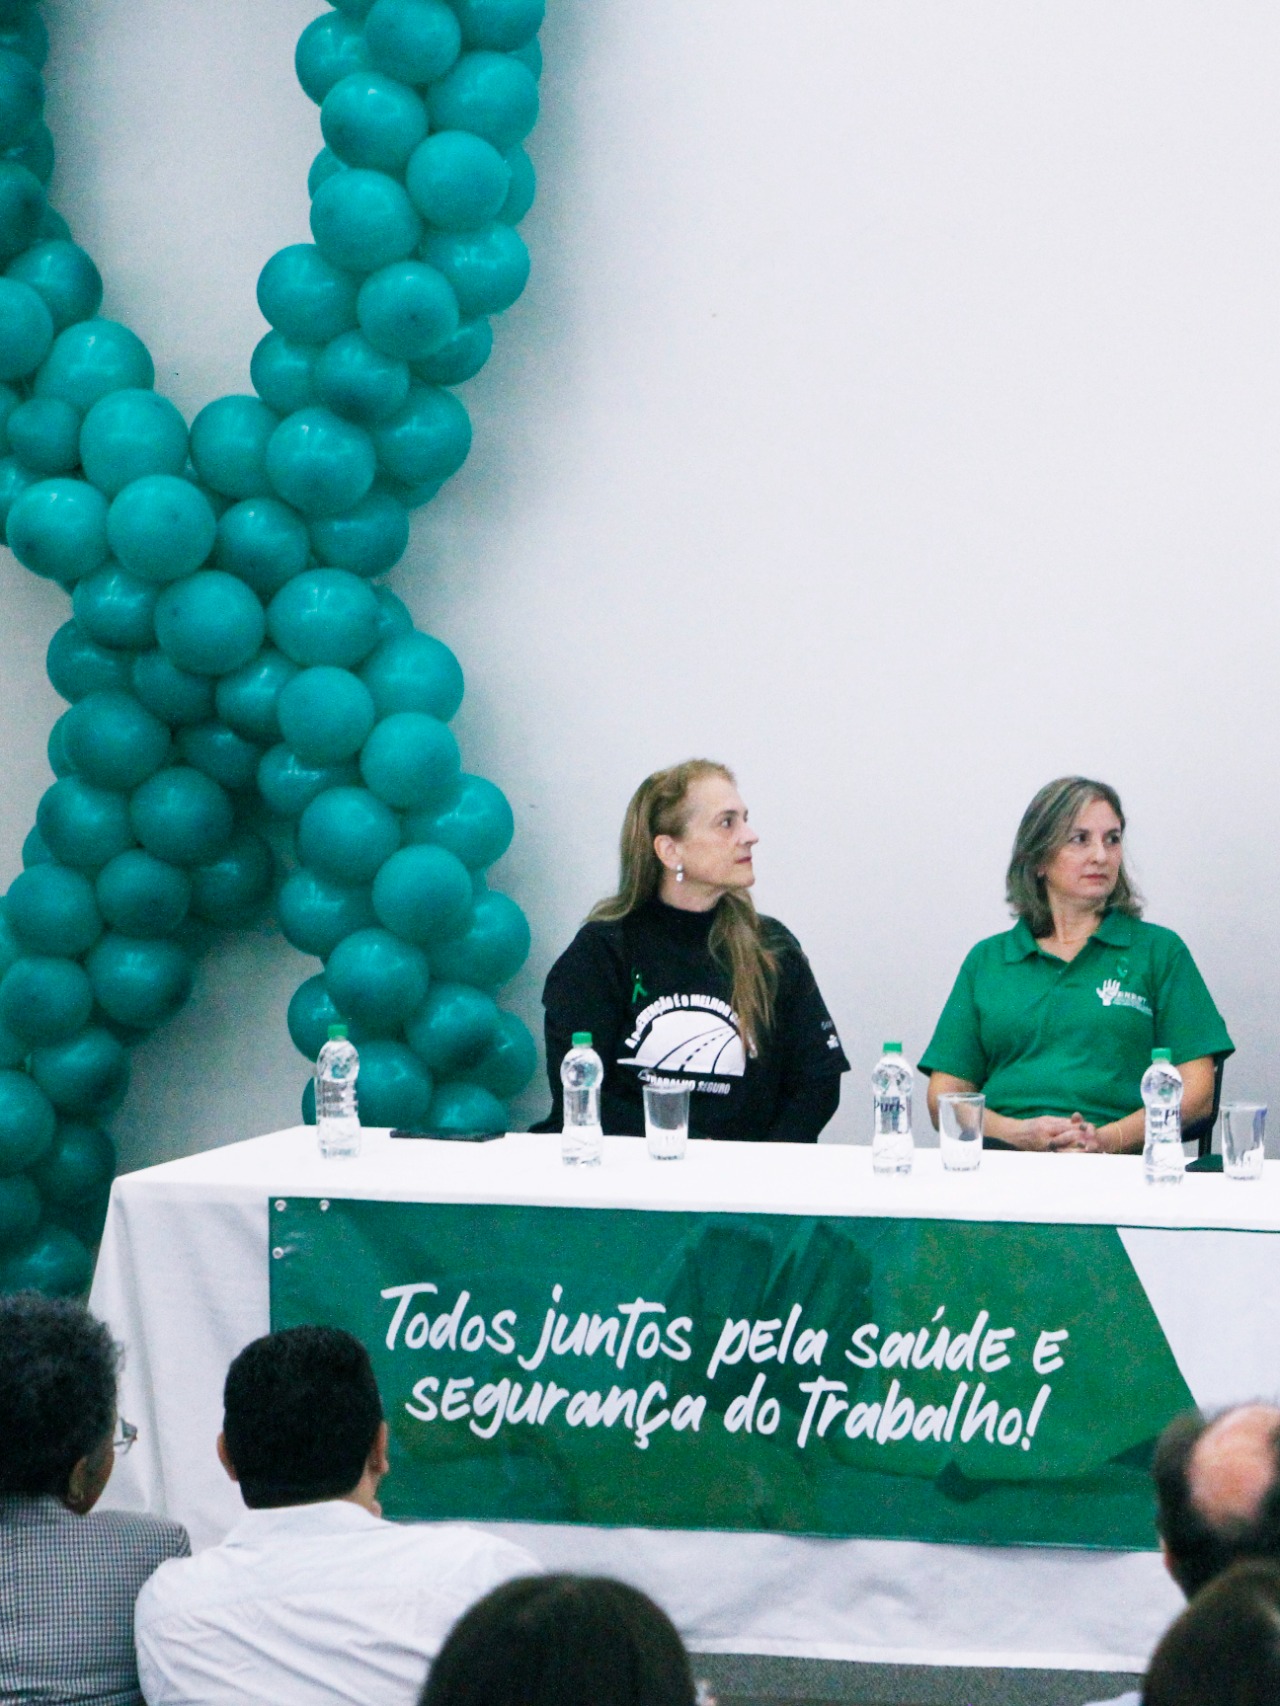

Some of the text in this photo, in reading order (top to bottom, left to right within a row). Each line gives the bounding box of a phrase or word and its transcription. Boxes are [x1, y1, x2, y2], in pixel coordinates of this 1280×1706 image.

[380, 1282, 517, 1355] Todos
[517, 1283, 693, 1371] juntos
[723, 1372, 781, 1435] do
